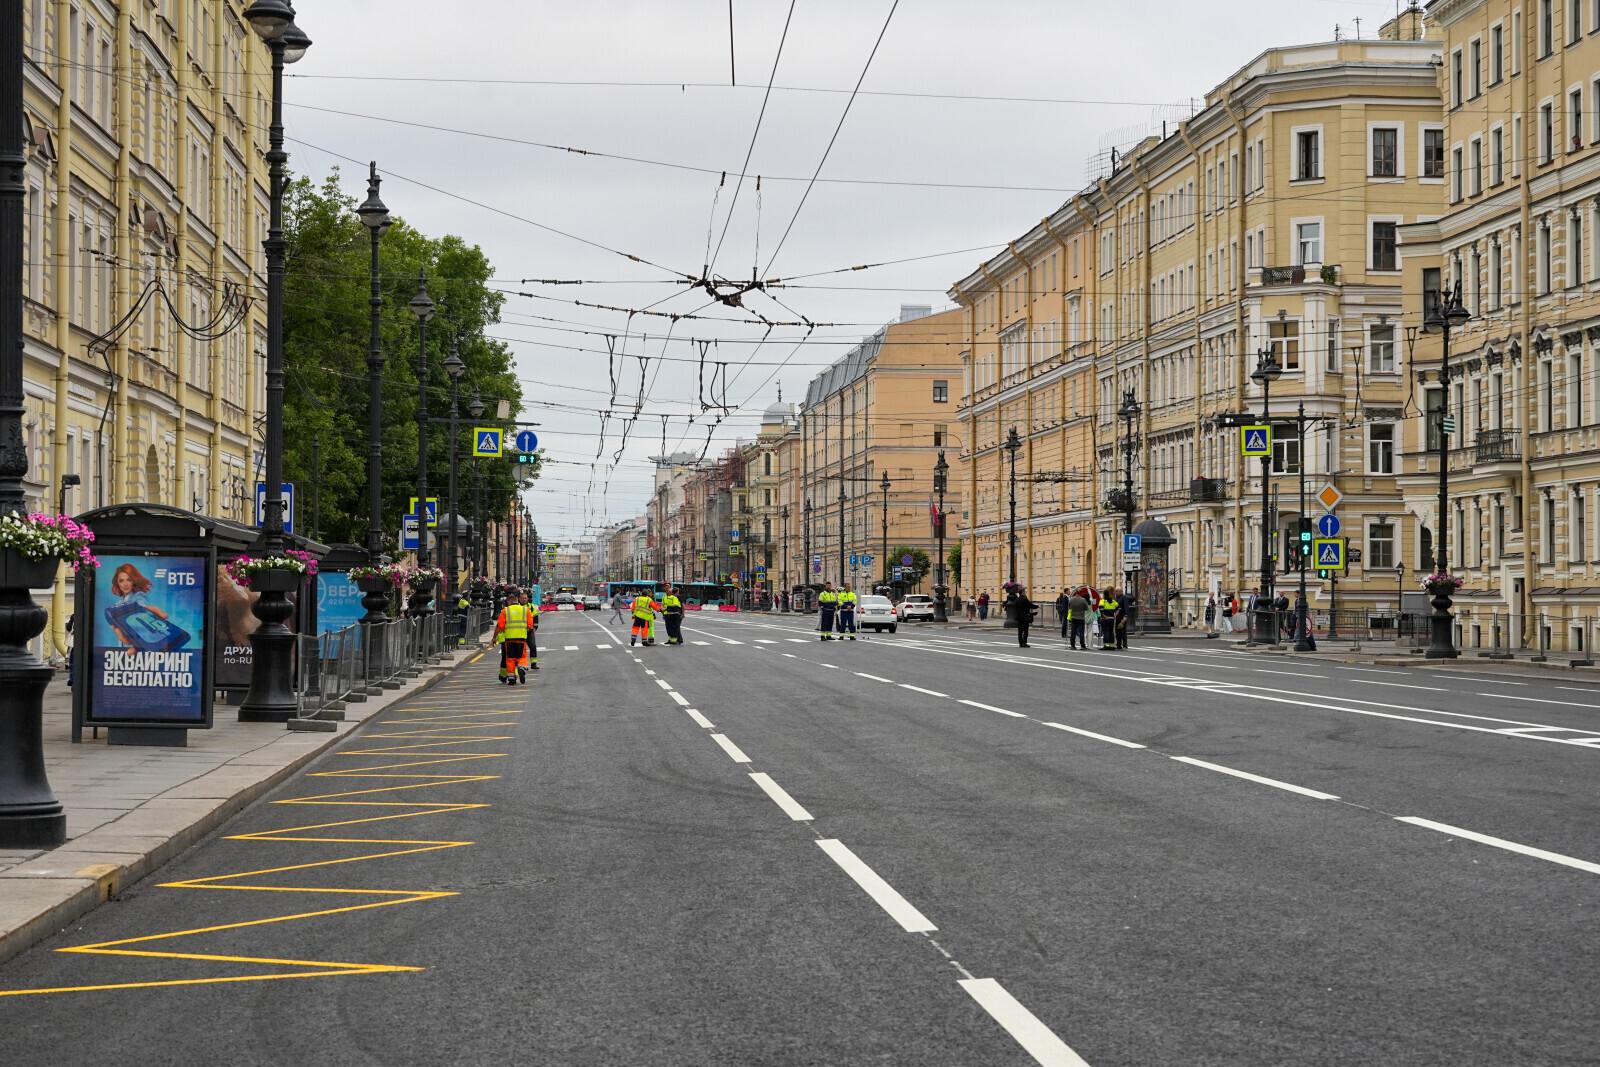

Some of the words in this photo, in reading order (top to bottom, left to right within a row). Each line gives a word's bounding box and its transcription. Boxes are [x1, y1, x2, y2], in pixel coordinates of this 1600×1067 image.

[1128, 536, 1138, 550] P
[1301, 532, 1311, 540] 60
[168, 572, 196, 586] ВТБ
[104, 650, 193, 672] ЭКВАЙРИНГ
[104, 671, 192, 688] БЕСПЛАТНО
